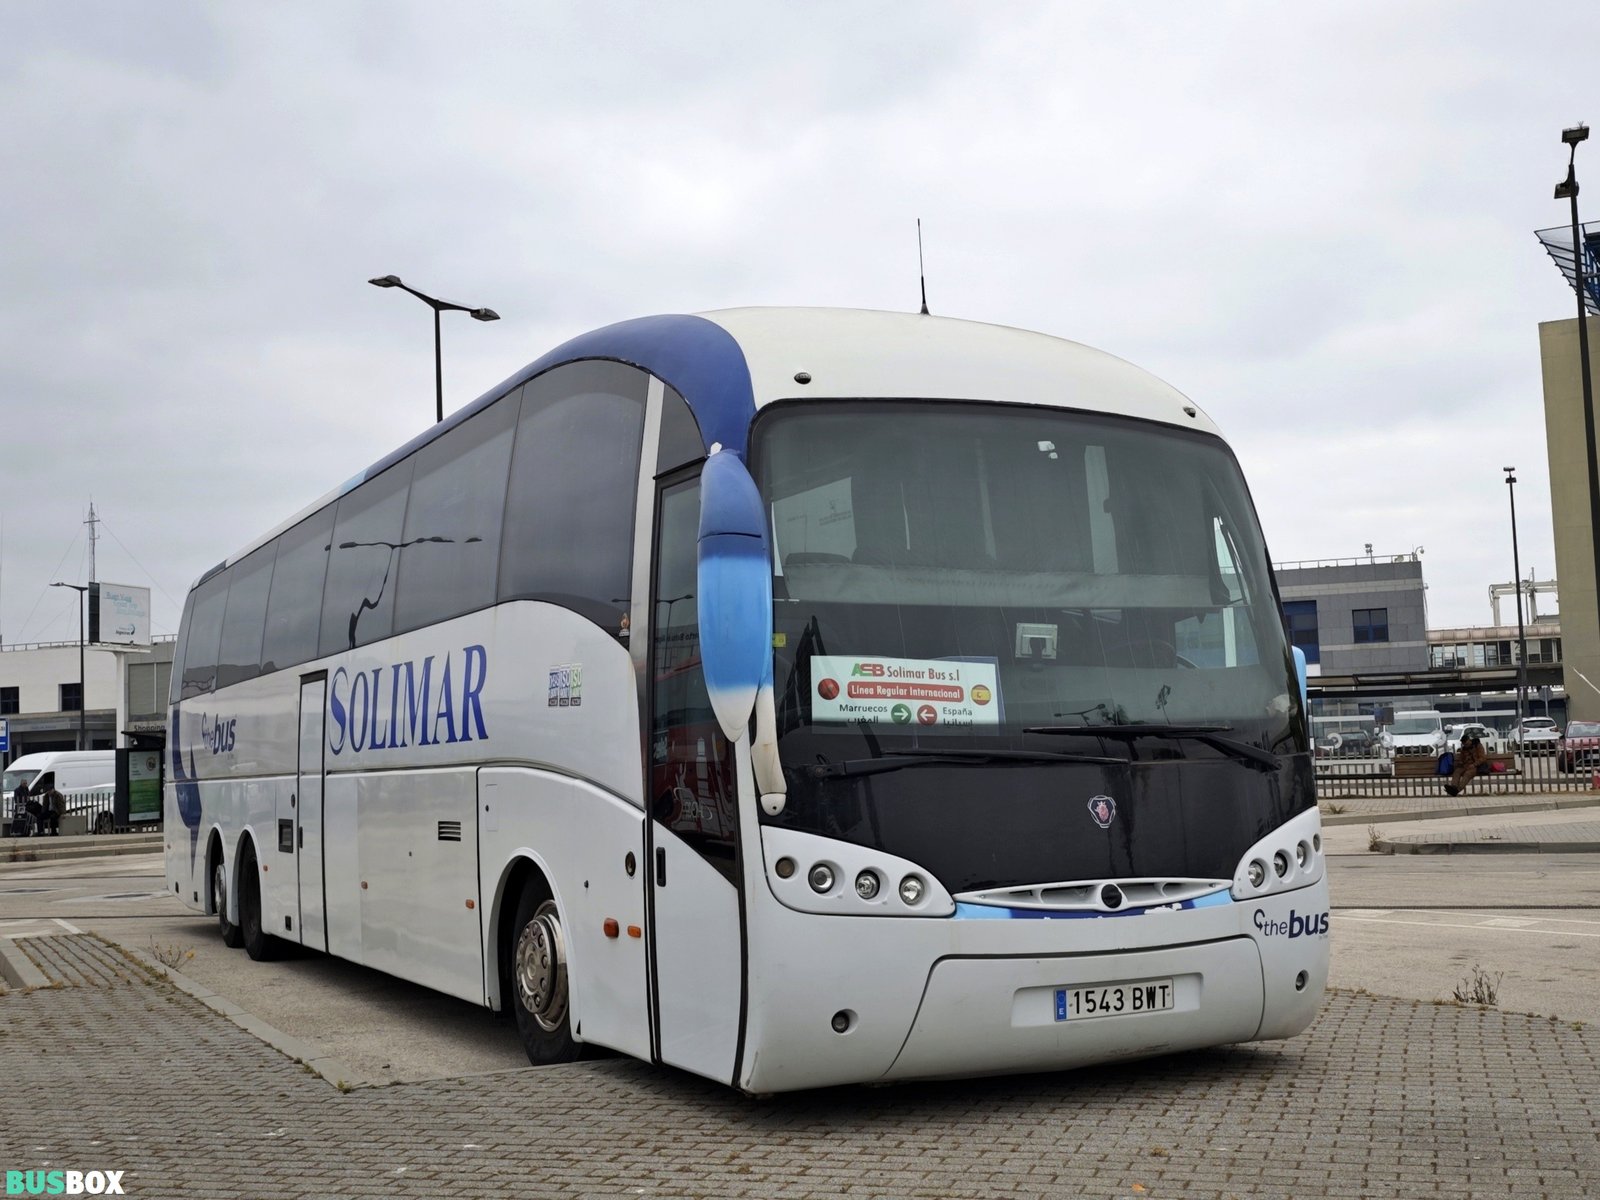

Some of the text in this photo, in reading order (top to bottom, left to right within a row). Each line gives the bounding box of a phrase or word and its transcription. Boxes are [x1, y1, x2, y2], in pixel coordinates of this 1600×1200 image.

[851, 663, 885, 677] ASB
[887, 666, 926, 679] Solimar
[928, 668, 946, 681] Bus
[329, 644, 489, 756] SOLIMAR
[876, 686, 908, 697] Regular
[909, 687, 961, 699] Internacional
[839, 704, 888, 712] Marruecos
[942, 706, 973, 717] España
[1264, 909, 1329, 939] thebus
[1074, 985, 1169, 1014] 1543 BWT
